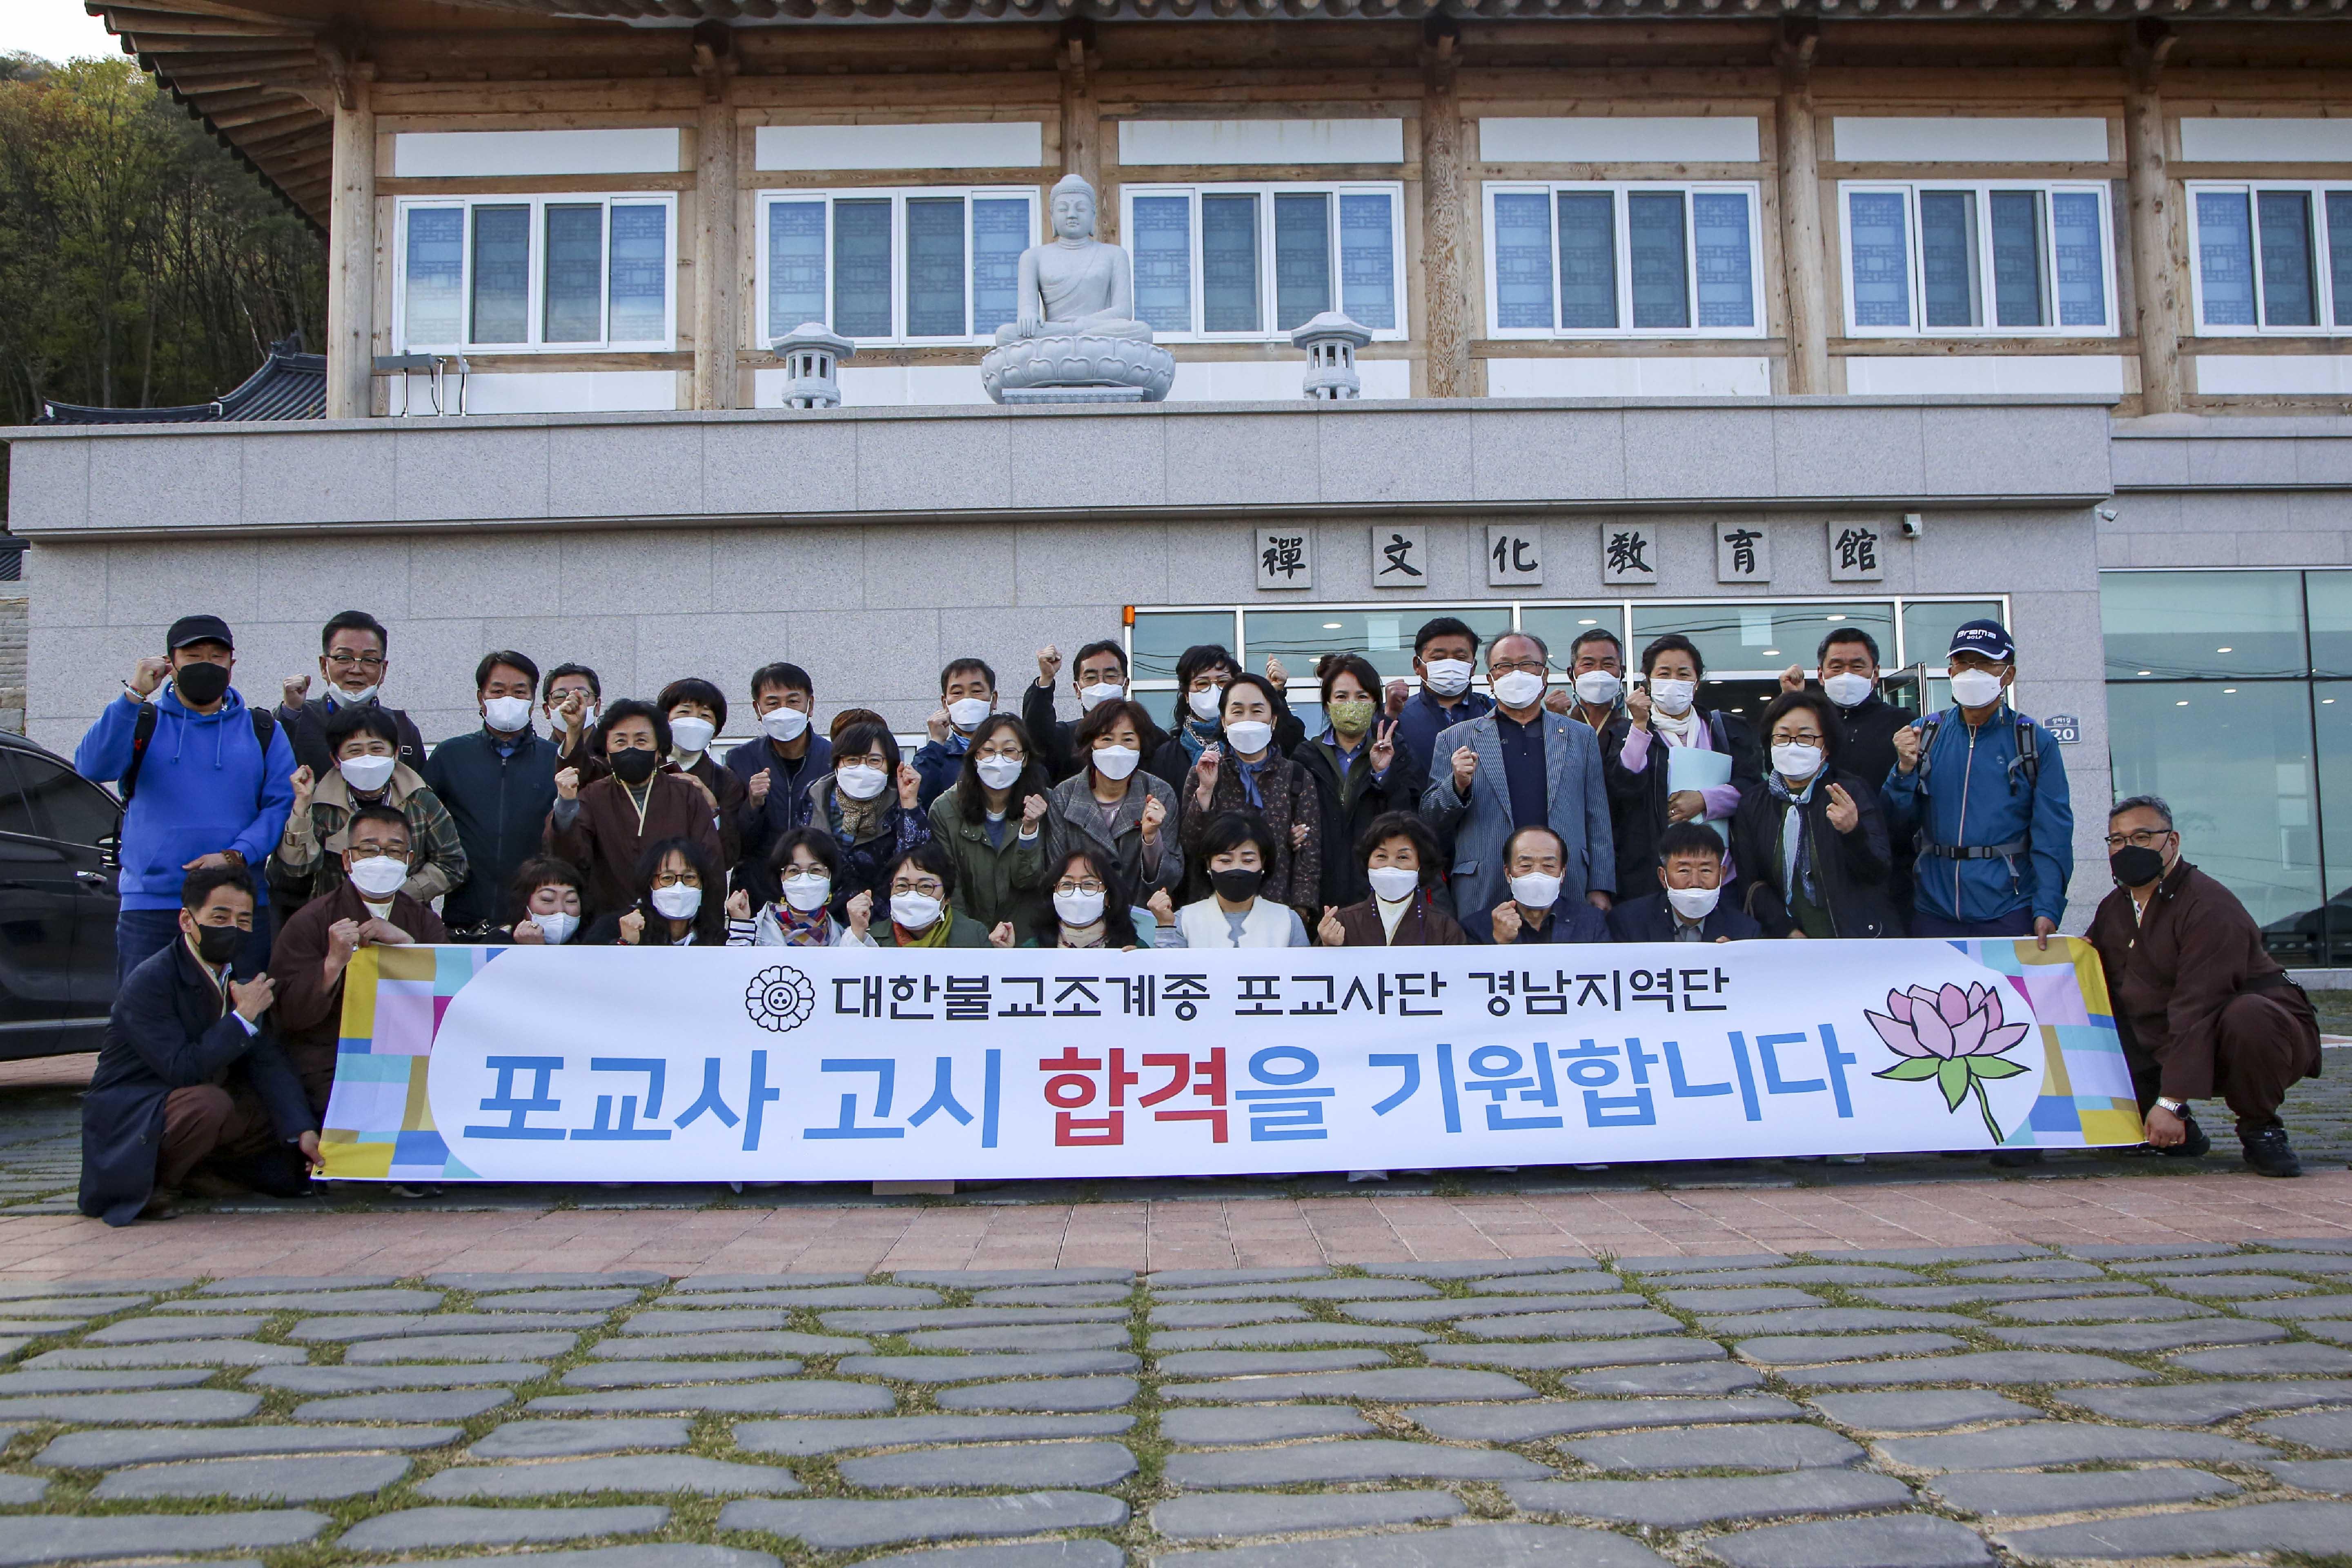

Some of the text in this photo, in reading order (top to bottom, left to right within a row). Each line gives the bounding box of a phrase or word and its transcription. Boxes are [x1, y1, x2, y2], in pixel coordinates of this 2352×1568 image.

[2050, 728, 2074, 740] 20
[832, 967, 1730, 1021] 대한불교조계종 포교사단 경남지역단
[463, 1023, 1857, 1151] 포교사 고시 합격을 기원합니다
